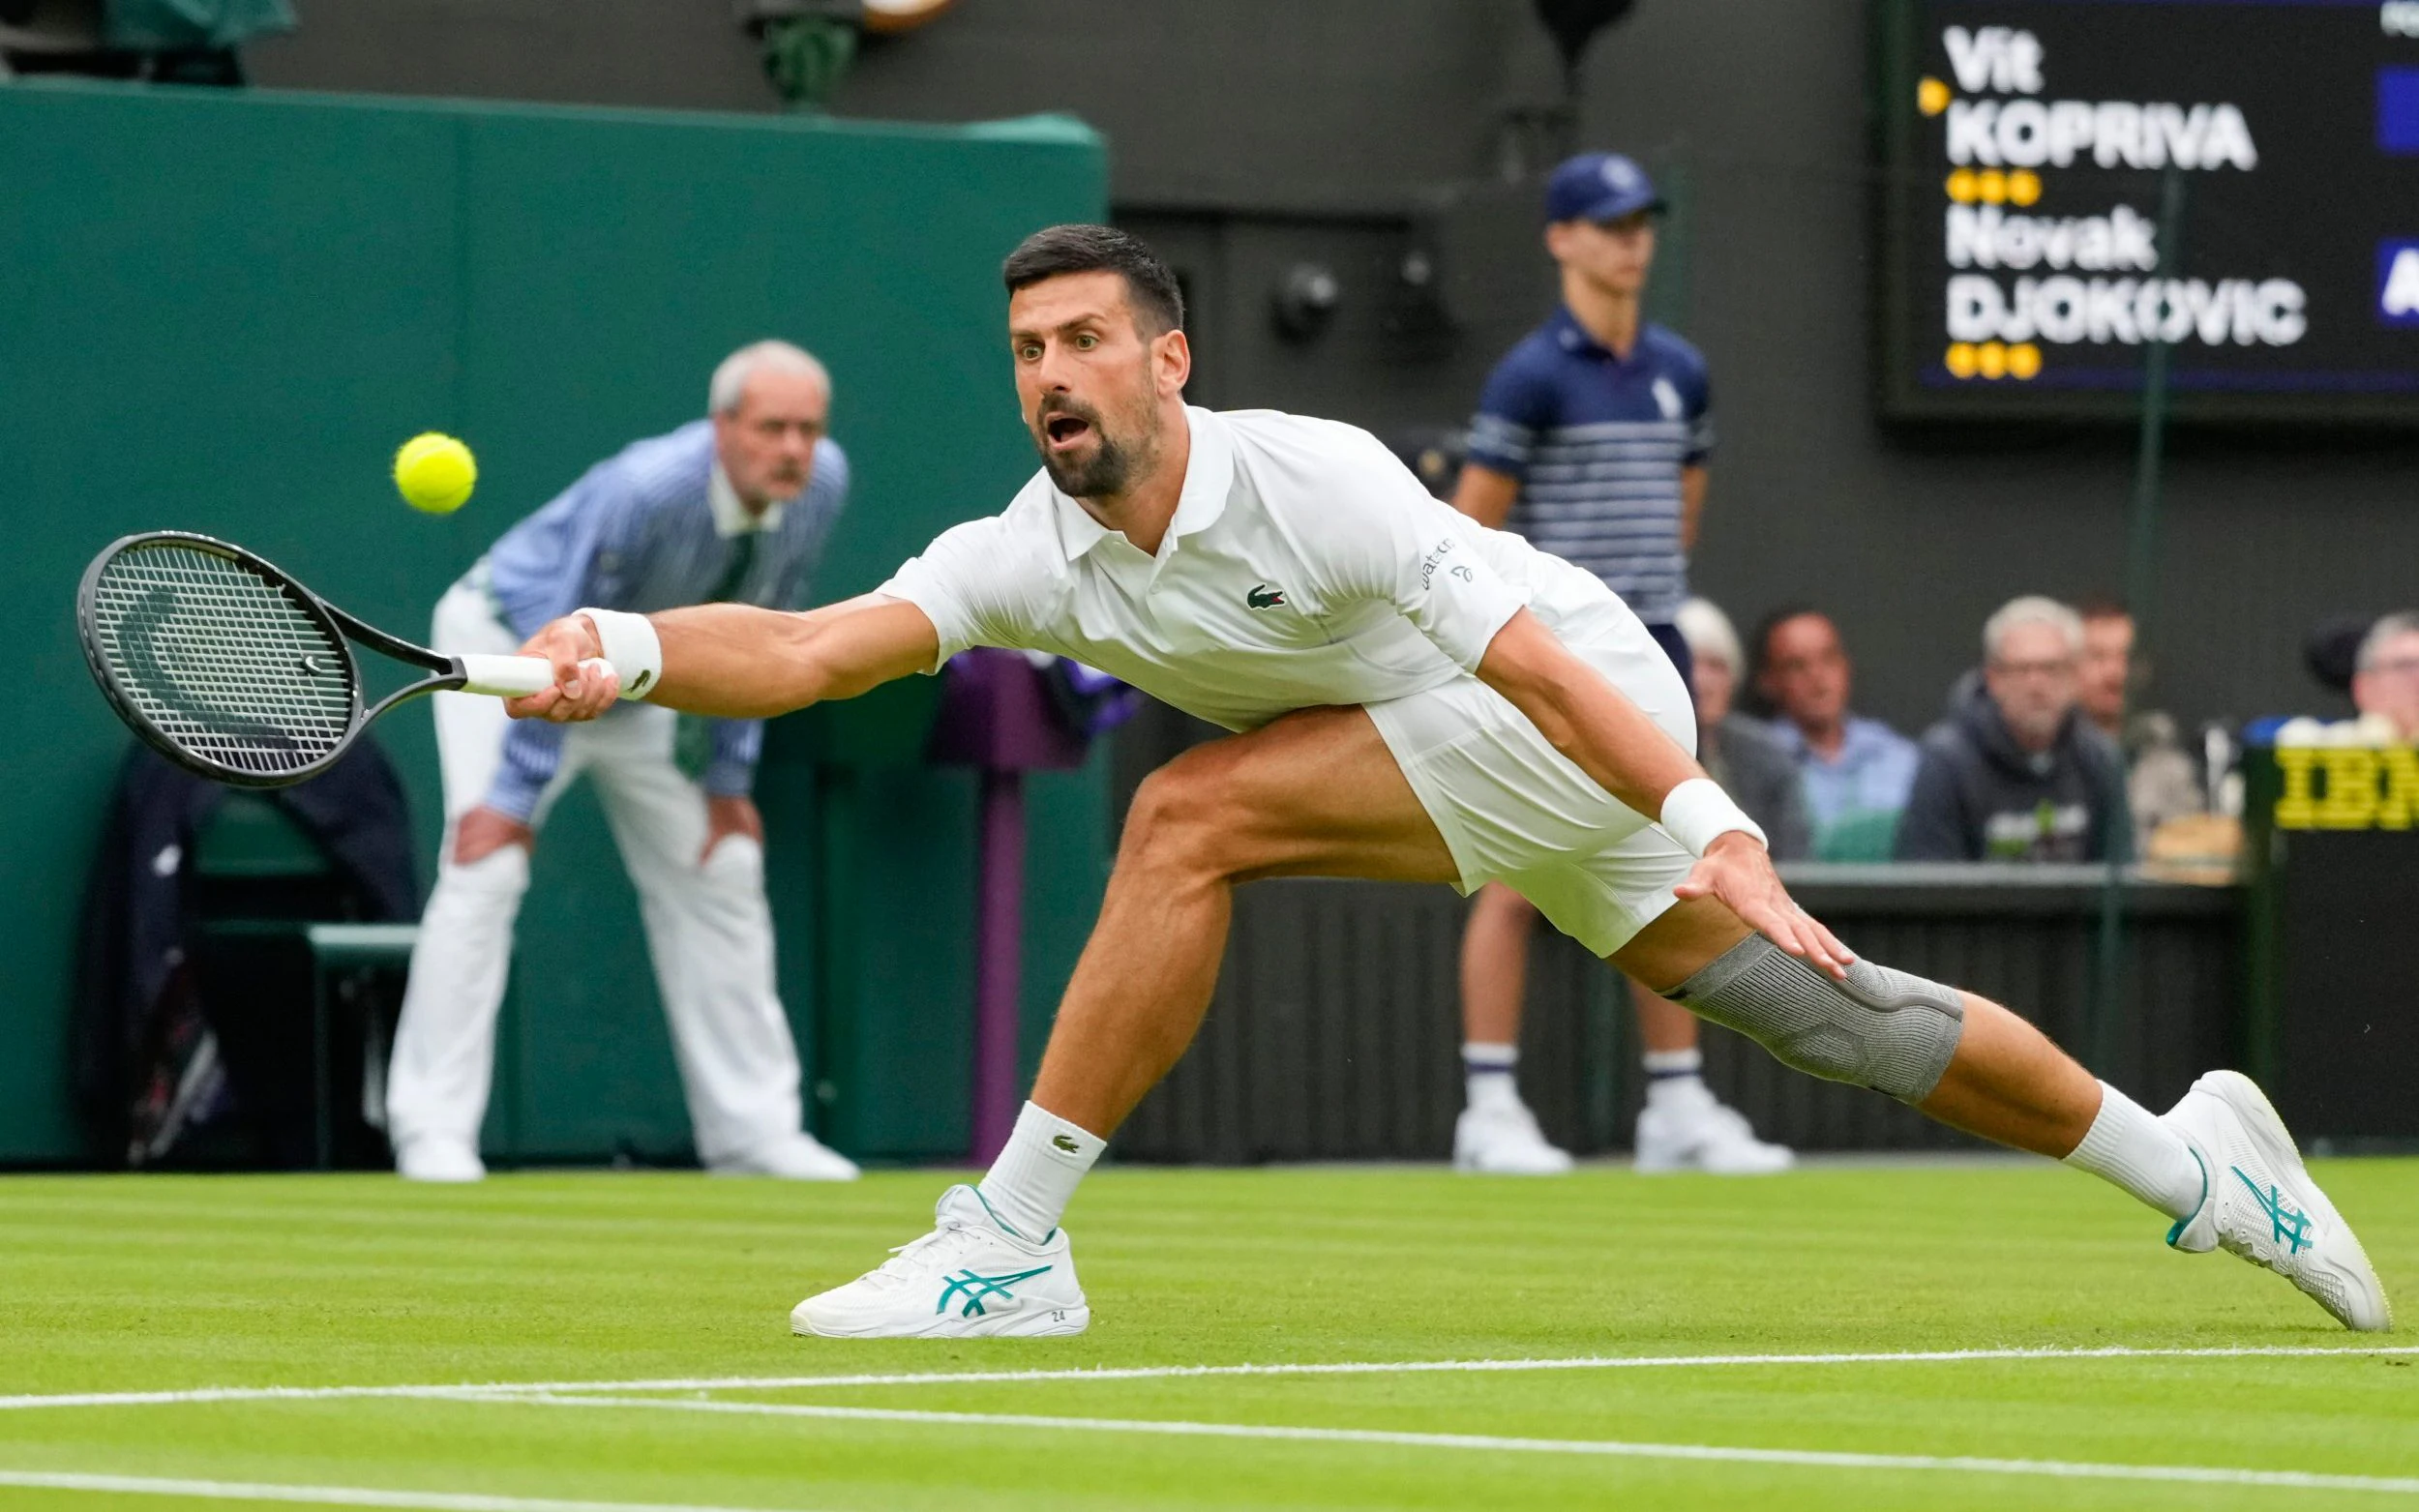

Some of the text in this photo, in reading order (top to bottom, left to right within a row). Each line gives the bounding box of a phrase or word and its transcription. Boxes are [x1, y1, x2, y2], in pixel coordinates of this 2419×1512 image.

[1946, 100, 2257, 171] KOPRIVA
[1946, 202, 2159, 272] Novak
[1946, 275, 2307, 347] DJOKOVIC
